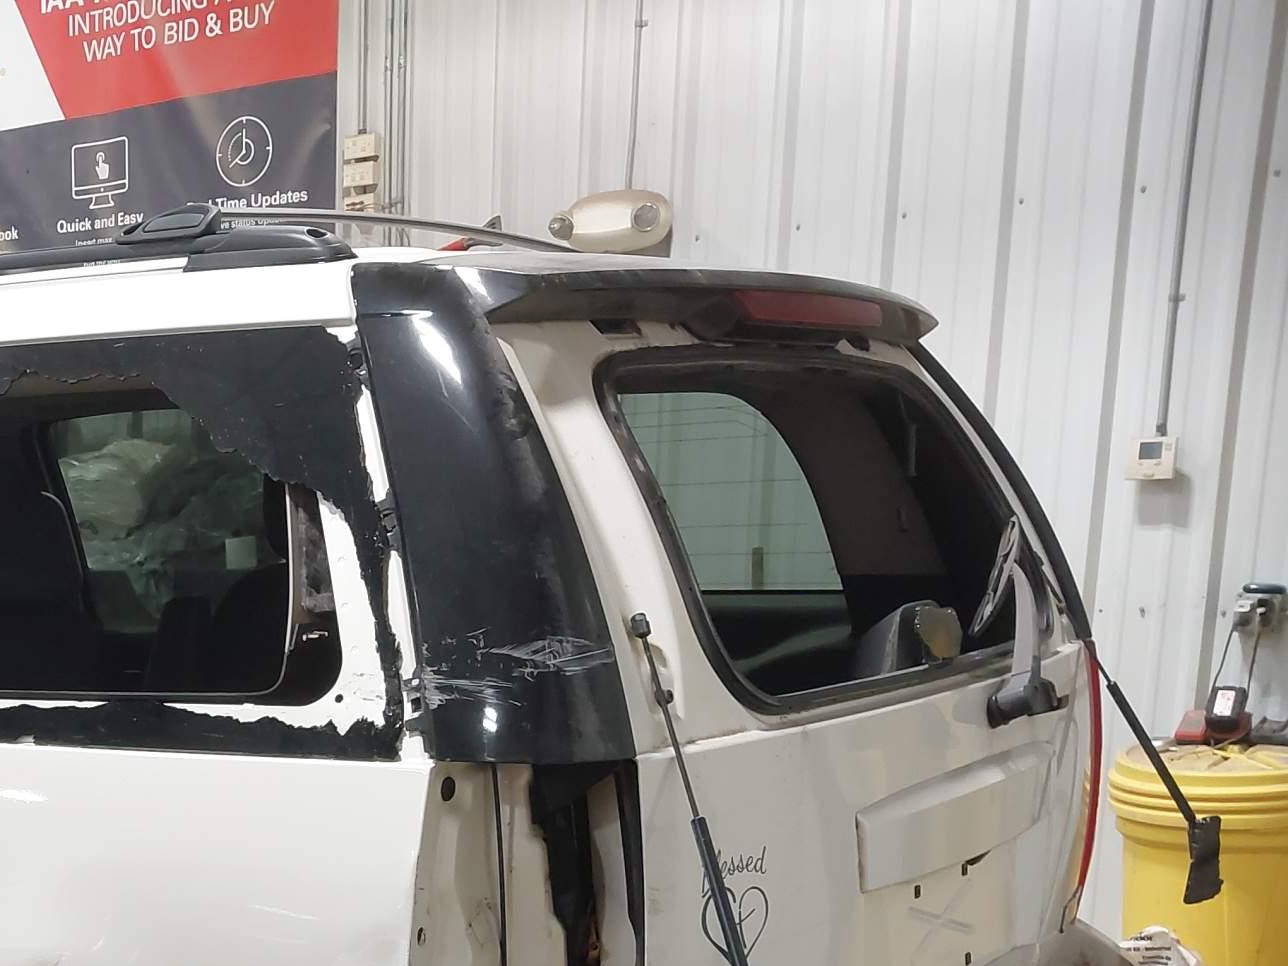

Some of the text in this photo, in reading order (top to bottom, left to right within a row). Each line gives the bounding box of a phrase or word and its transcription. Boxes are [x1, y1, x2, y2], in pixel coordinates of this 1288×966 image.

[83, 1, 275, 62] WAY TO BID & BUY
[215, 197, 248, 209] Time
[250, 190, 309, 210] Updates
[56, 211, 144, 234] Quick and Easy
